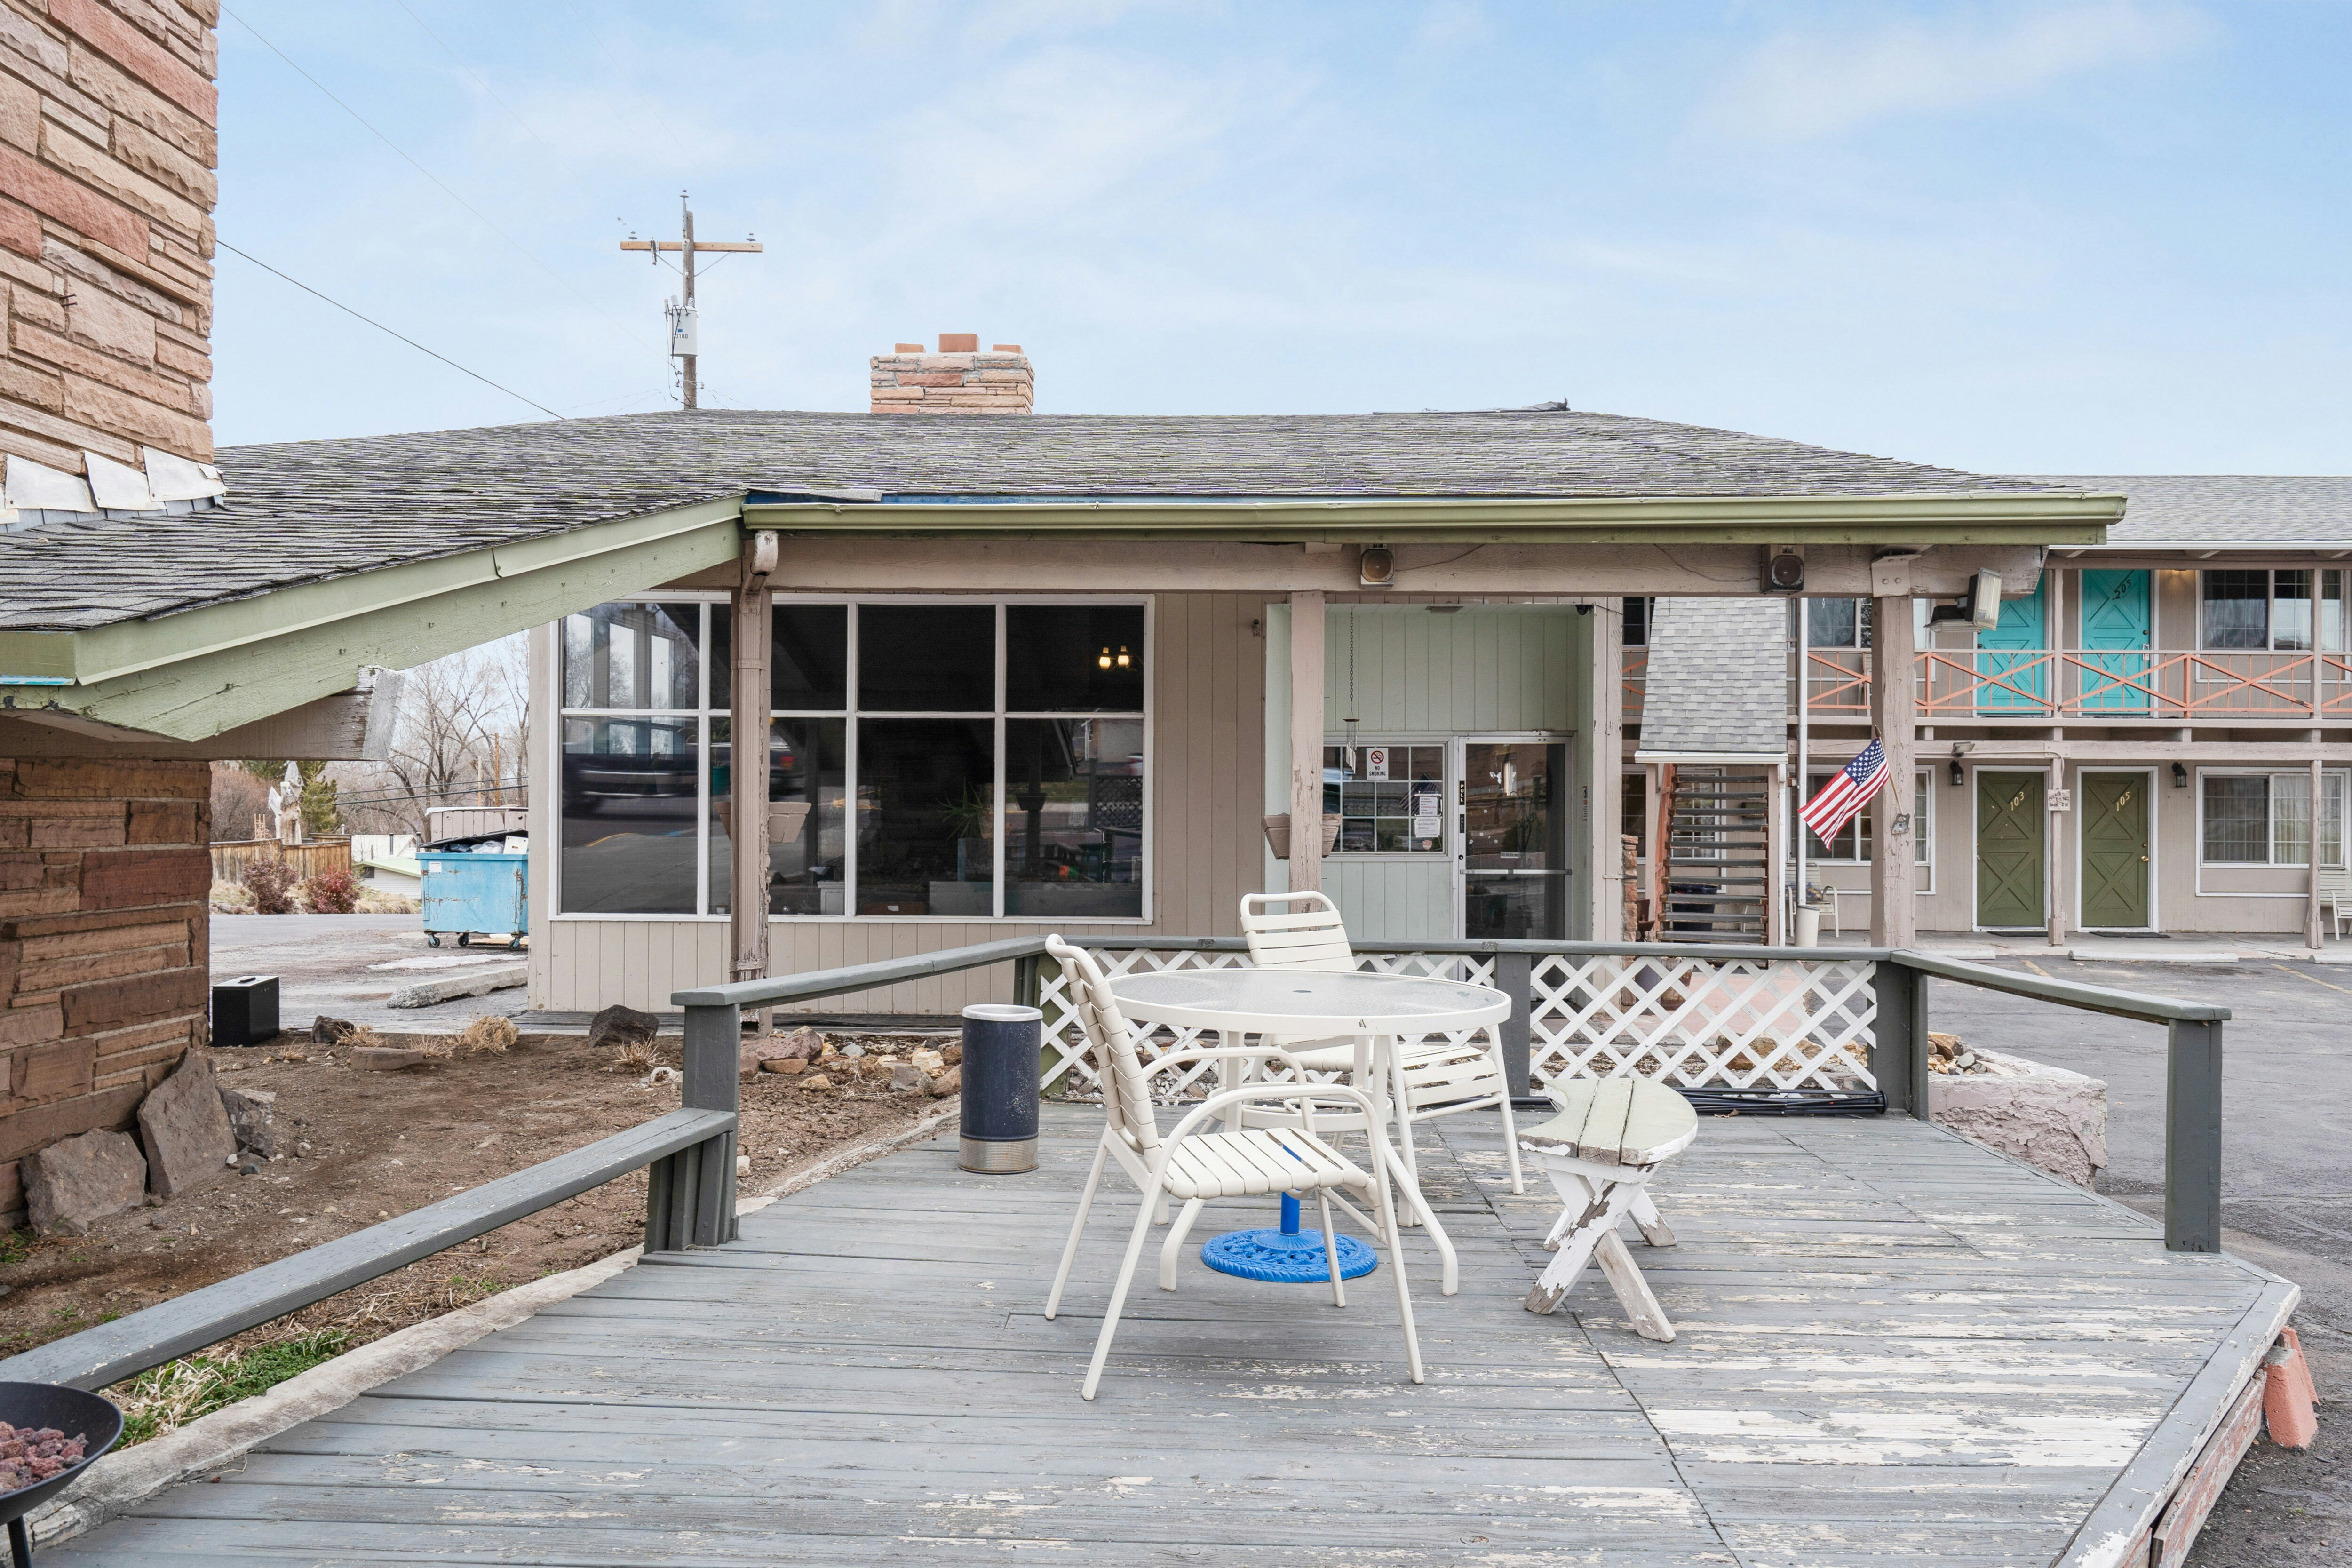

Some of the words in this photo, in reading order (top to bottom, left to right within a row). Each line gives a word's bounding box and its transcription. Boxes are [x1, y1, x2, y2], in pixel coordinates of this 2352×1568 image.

[2114, 579, 2131, 599] 205
[2010, 791, 2024, 811] 103
[2116, 791, 2130, 811] 105
